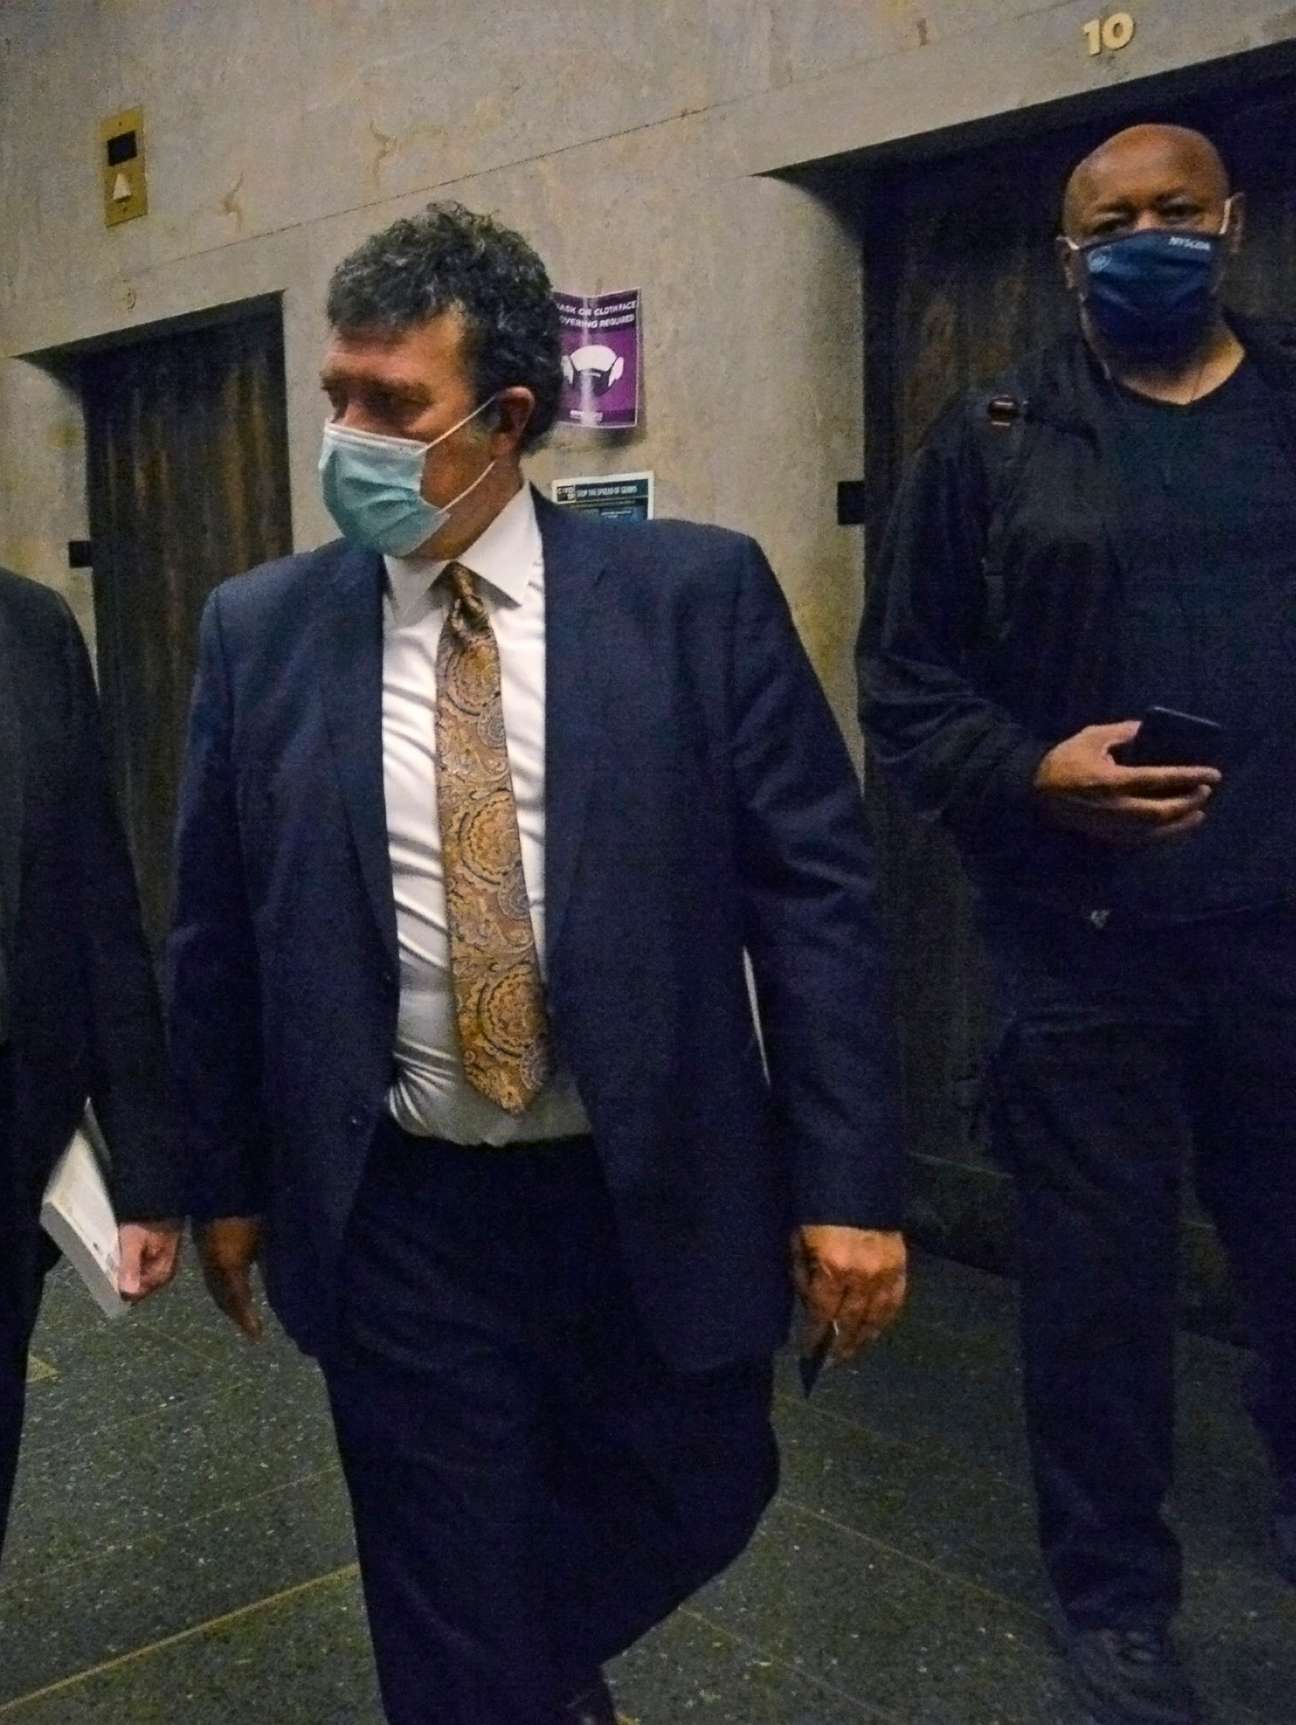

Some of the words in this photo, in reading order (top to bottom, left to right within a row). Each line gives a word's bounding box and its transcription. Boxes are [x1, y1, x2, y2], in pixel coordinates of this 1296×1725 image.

[1083, 13, 1134, 55] 10
[577, 308, 592, 316] OR
[594, 305, 617, 316] CLOTH
[618, 300, 636, 311] FACE
[598, 314, 635, 328] REQUIRED
